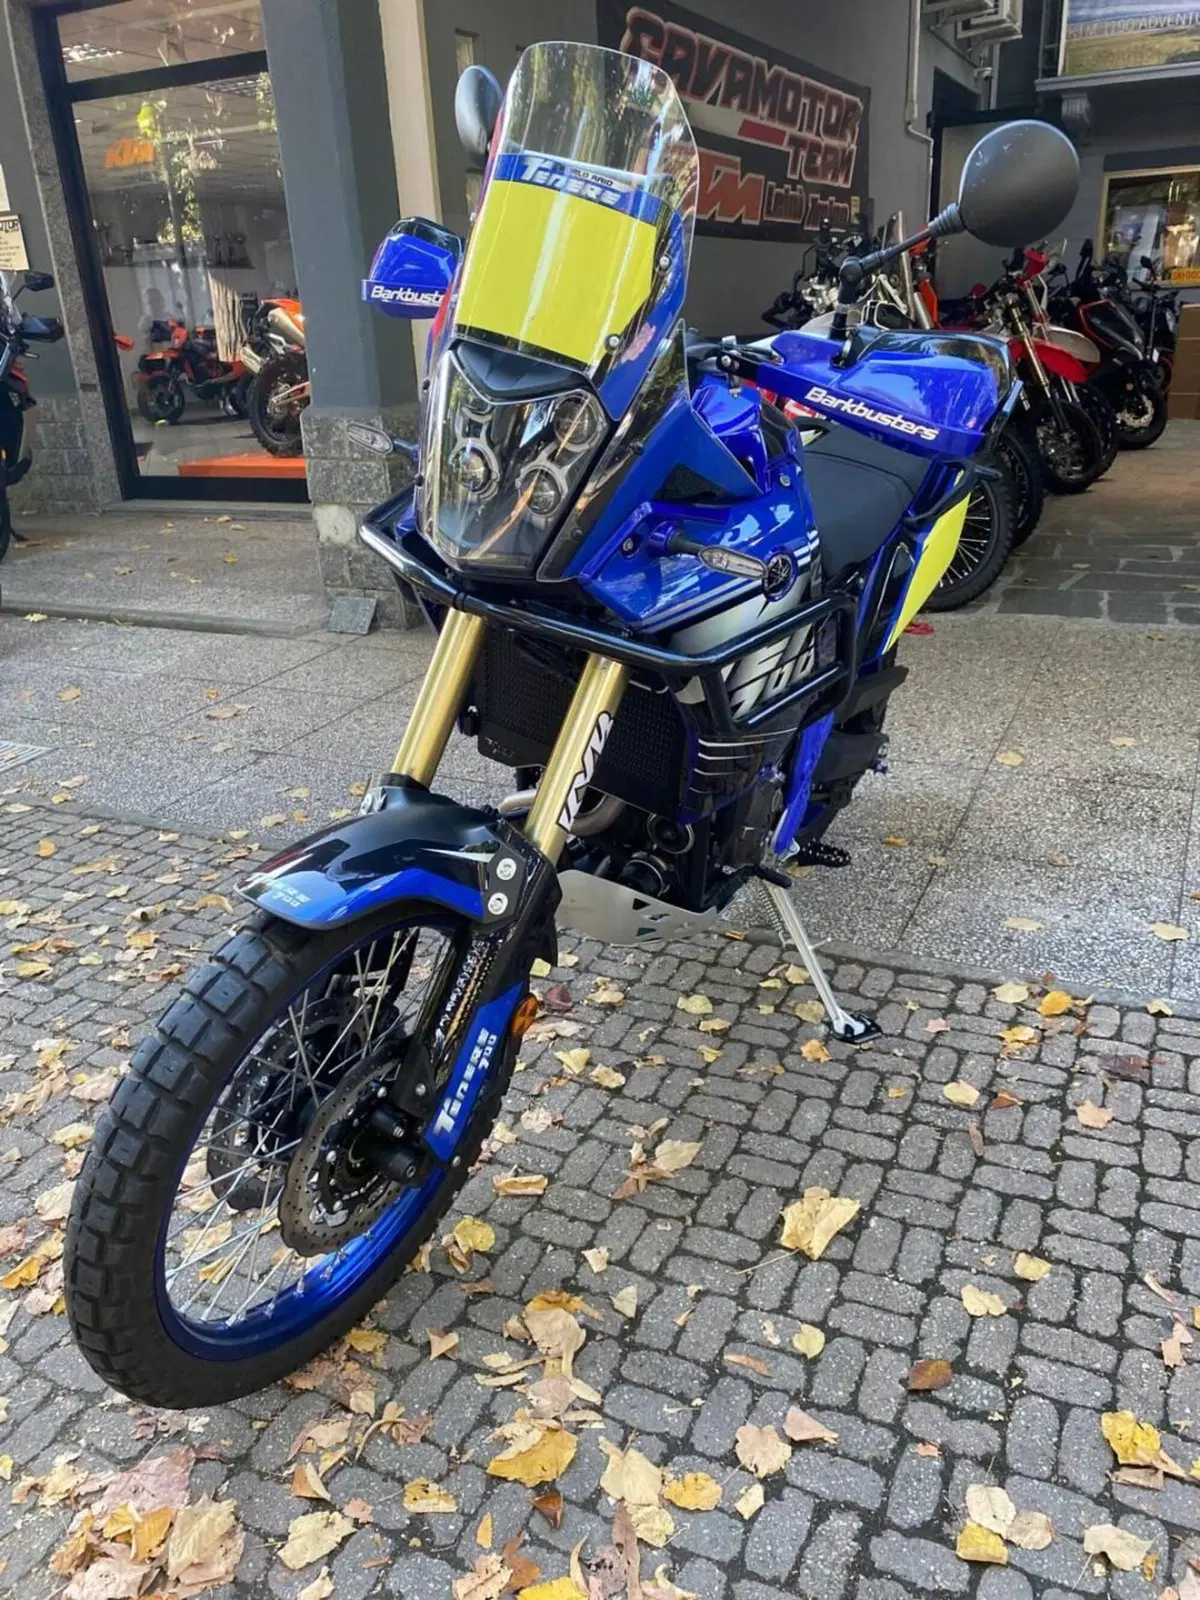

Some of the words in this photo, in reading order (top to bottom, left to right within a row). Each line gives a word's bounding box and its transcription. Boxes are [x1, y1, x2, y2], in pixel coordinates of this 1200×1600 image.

[784, 132, 857, 188] TEAM
[804, 386, 940, 441] Barkbusters
[478, 1033, 498, 1071] 700
